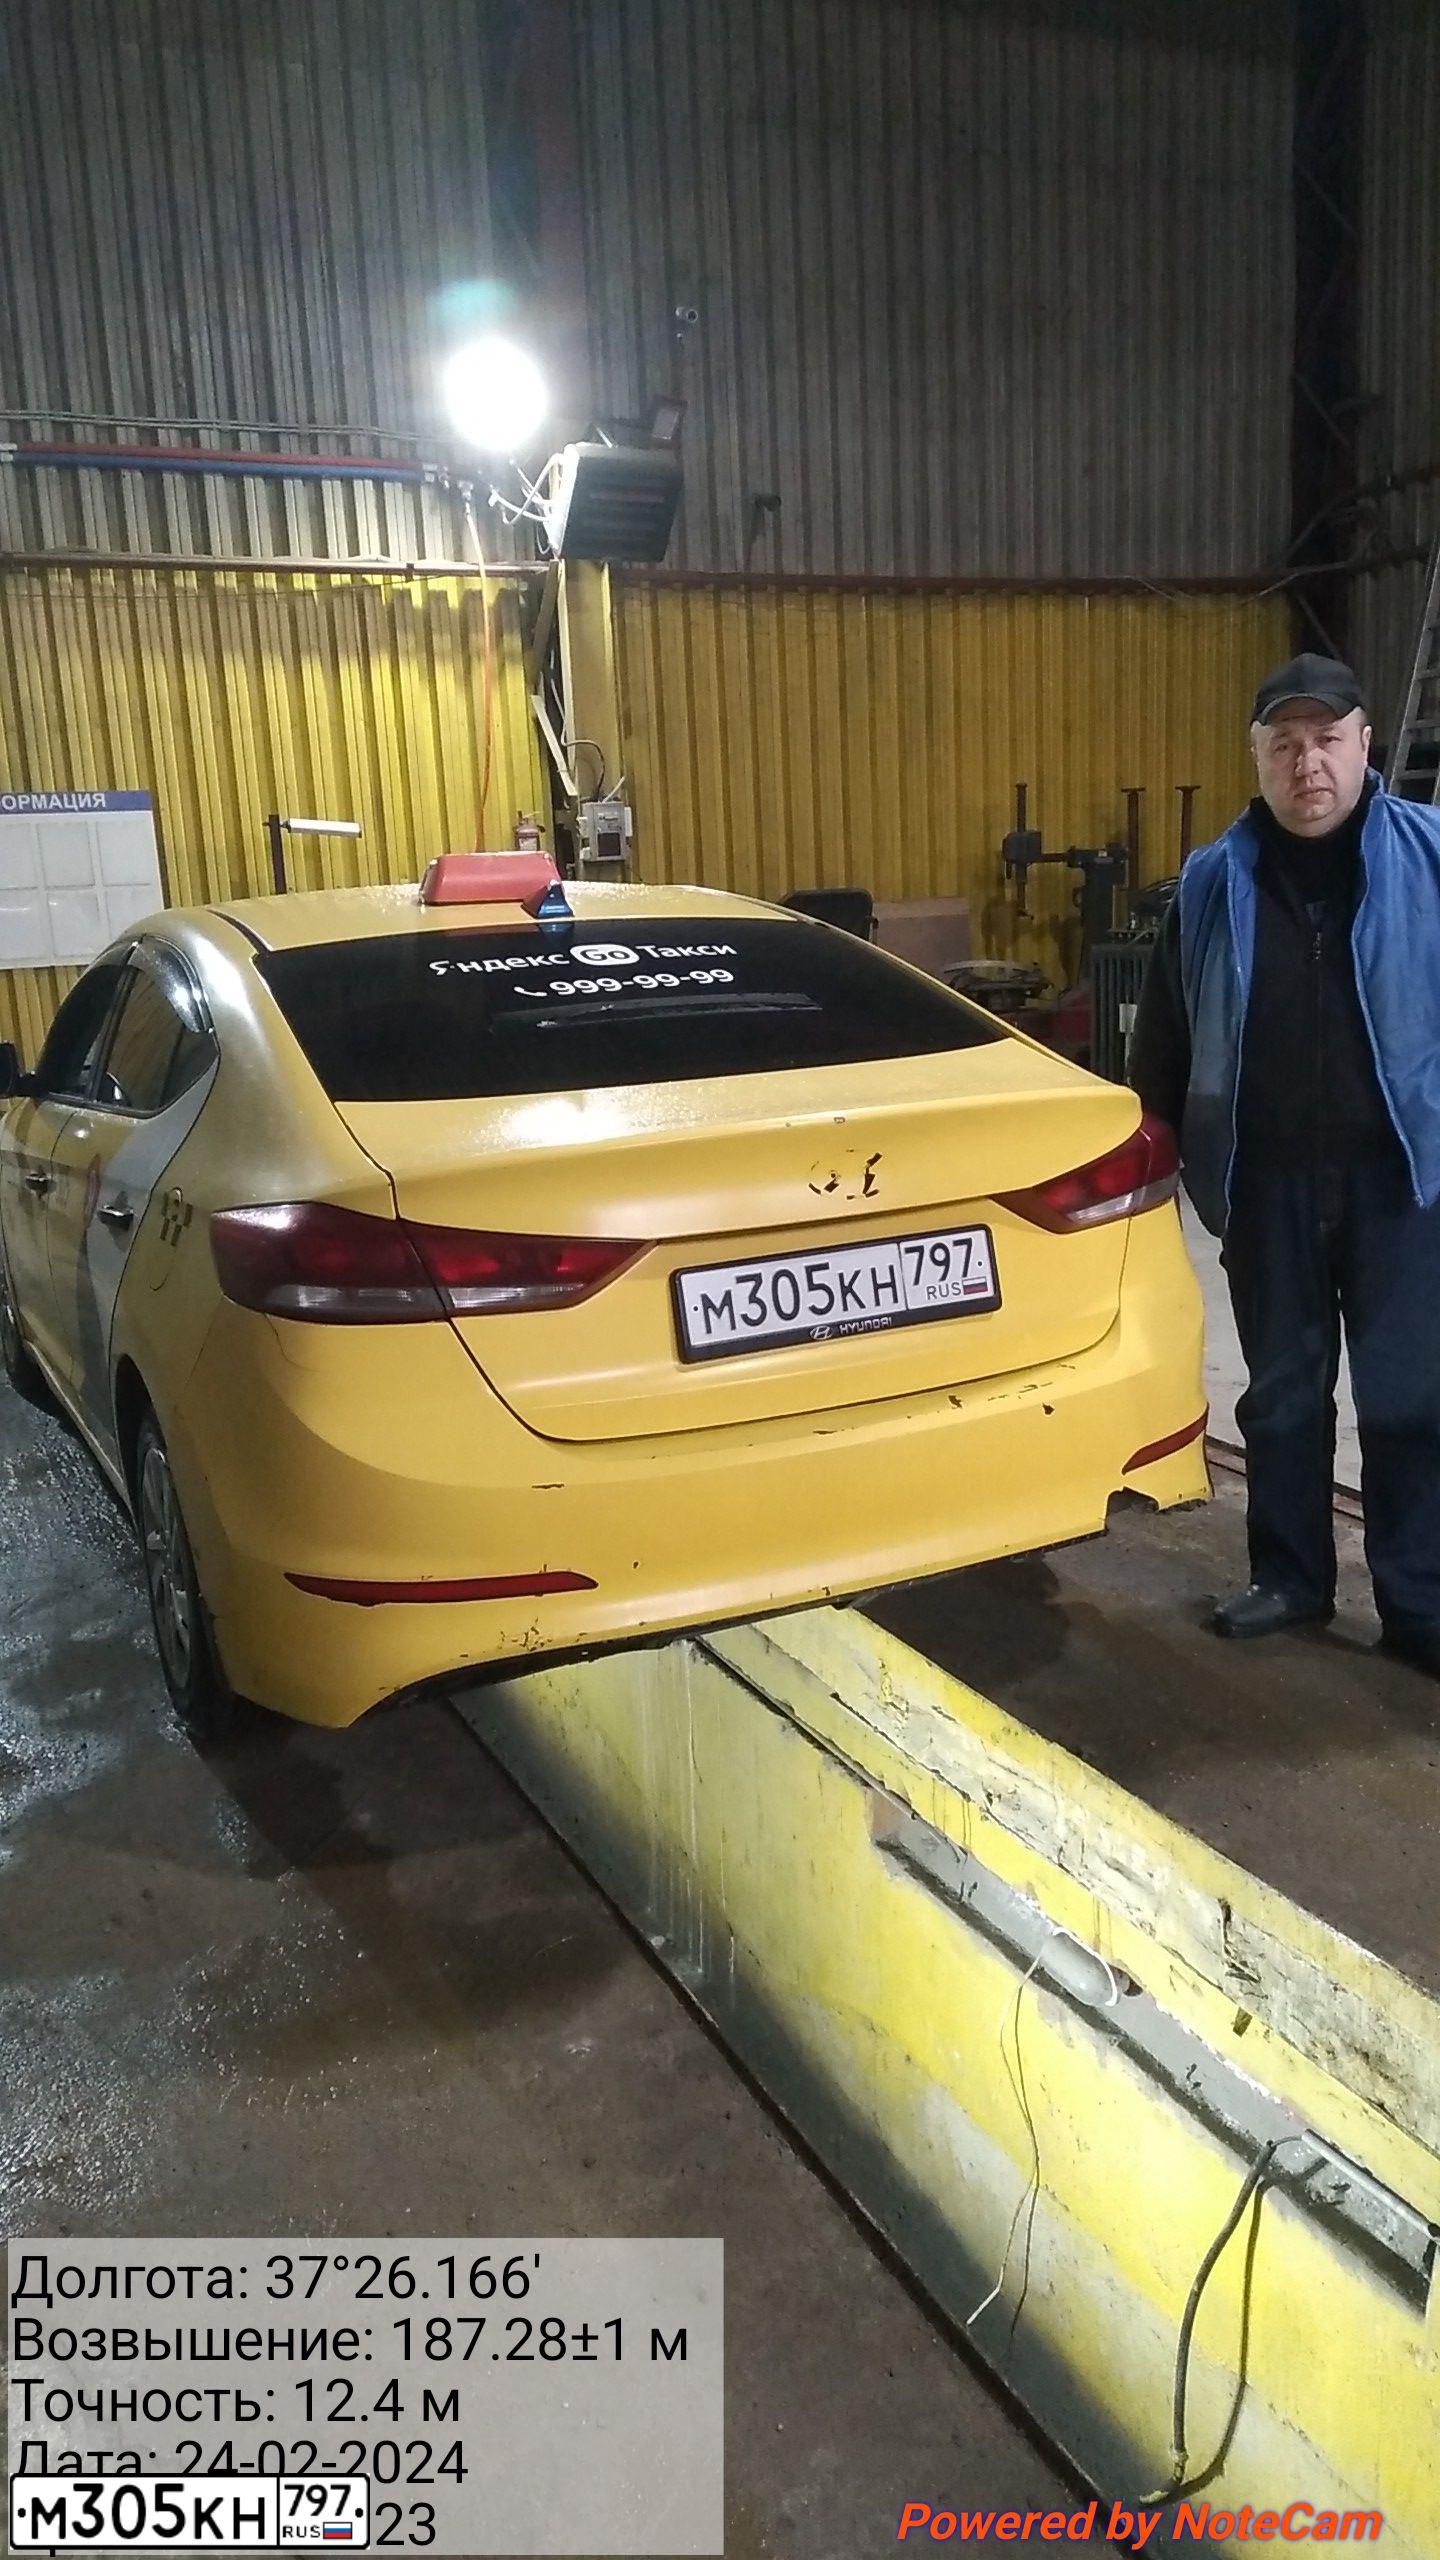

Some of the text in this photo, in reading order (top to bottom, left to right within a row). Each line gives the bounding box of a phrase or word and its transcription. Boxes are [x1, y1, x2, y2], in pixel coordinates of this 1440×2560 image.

[634, 945, 738, 959] Такси
[549, 969, 734, 996] 999-99-99
[904, 1238, 973, 1287] 797
[926, 1281, 962, 1301] RUS
[840, 1317, 892, 1335] HYUNDAI
